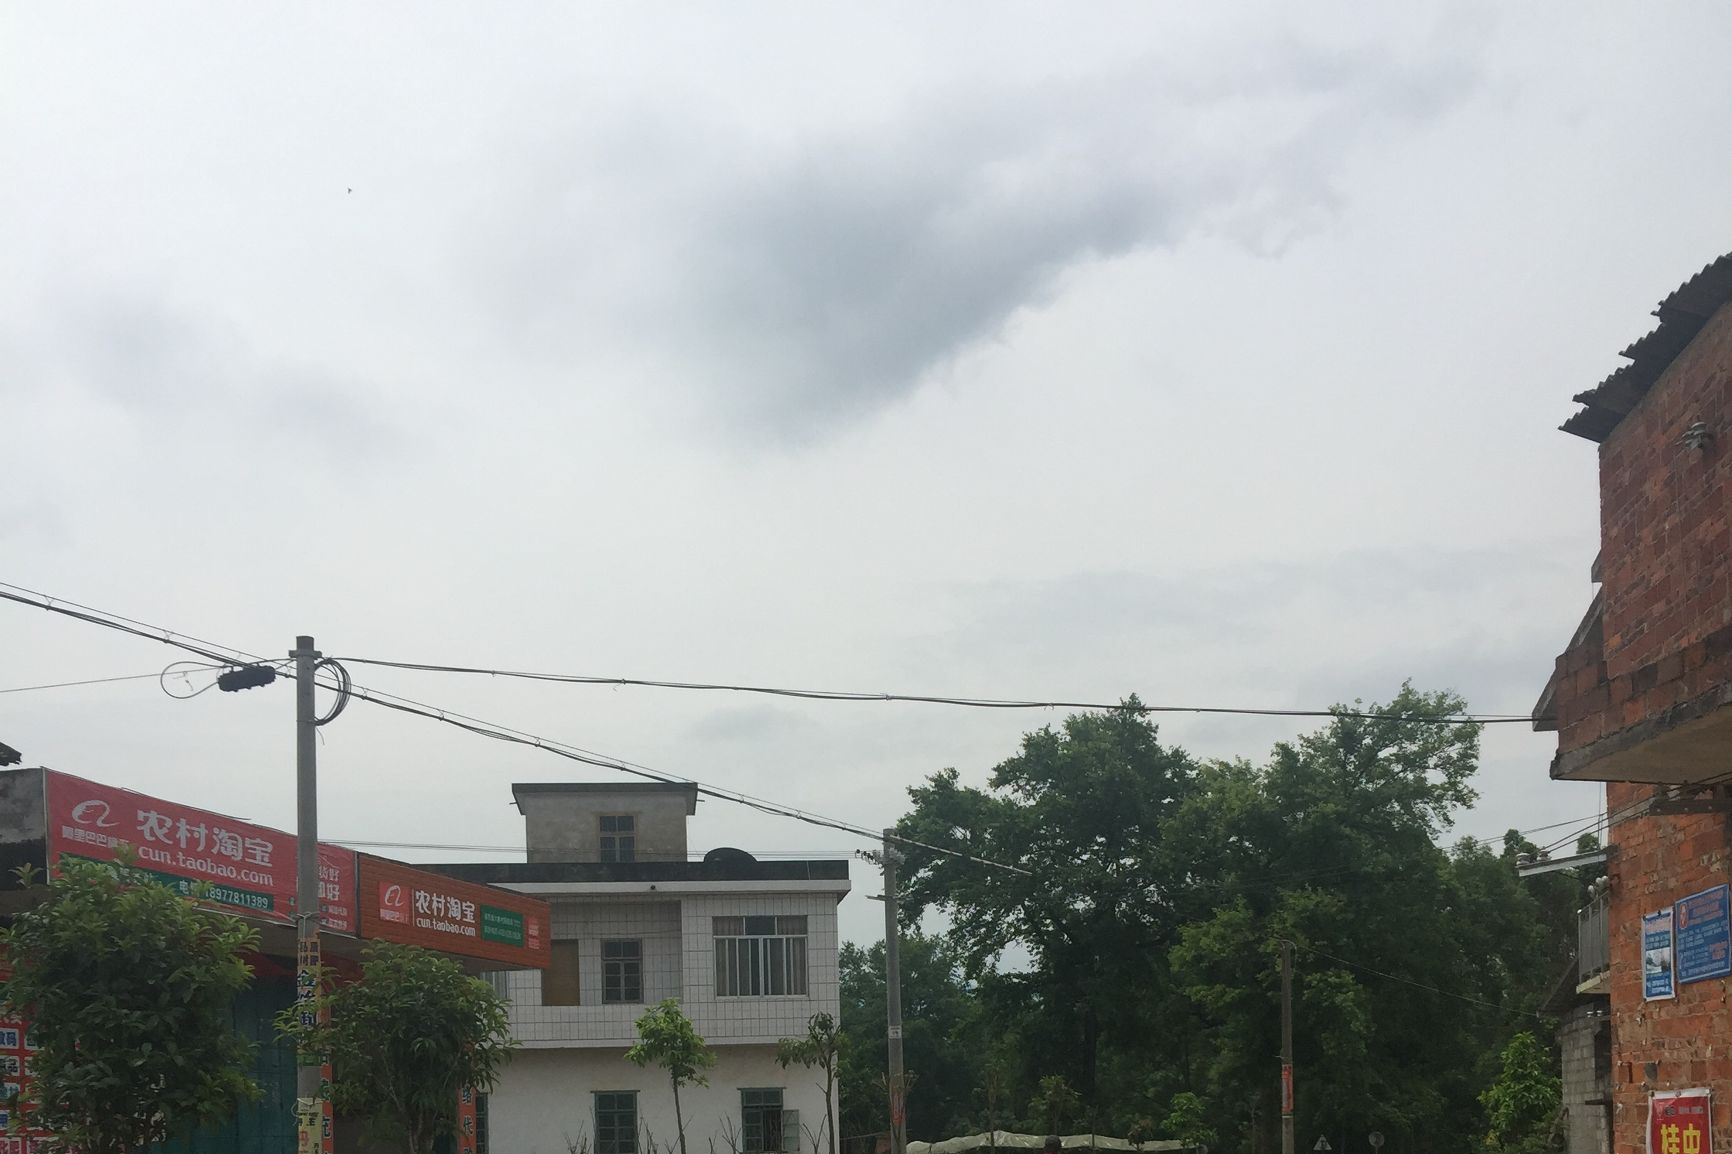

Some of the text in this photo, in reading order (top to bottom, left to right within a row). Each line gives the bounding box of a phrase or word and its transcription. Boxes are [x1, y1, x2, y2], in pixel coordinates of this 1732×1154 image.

[136, 809, 274, 868] 农村淘宝
[138, 846, 274, 887] cun.taobao.com
[415, 890, 476, 924] 农村淘宝
[416, 917, 476, 937] cun.taobao.com
